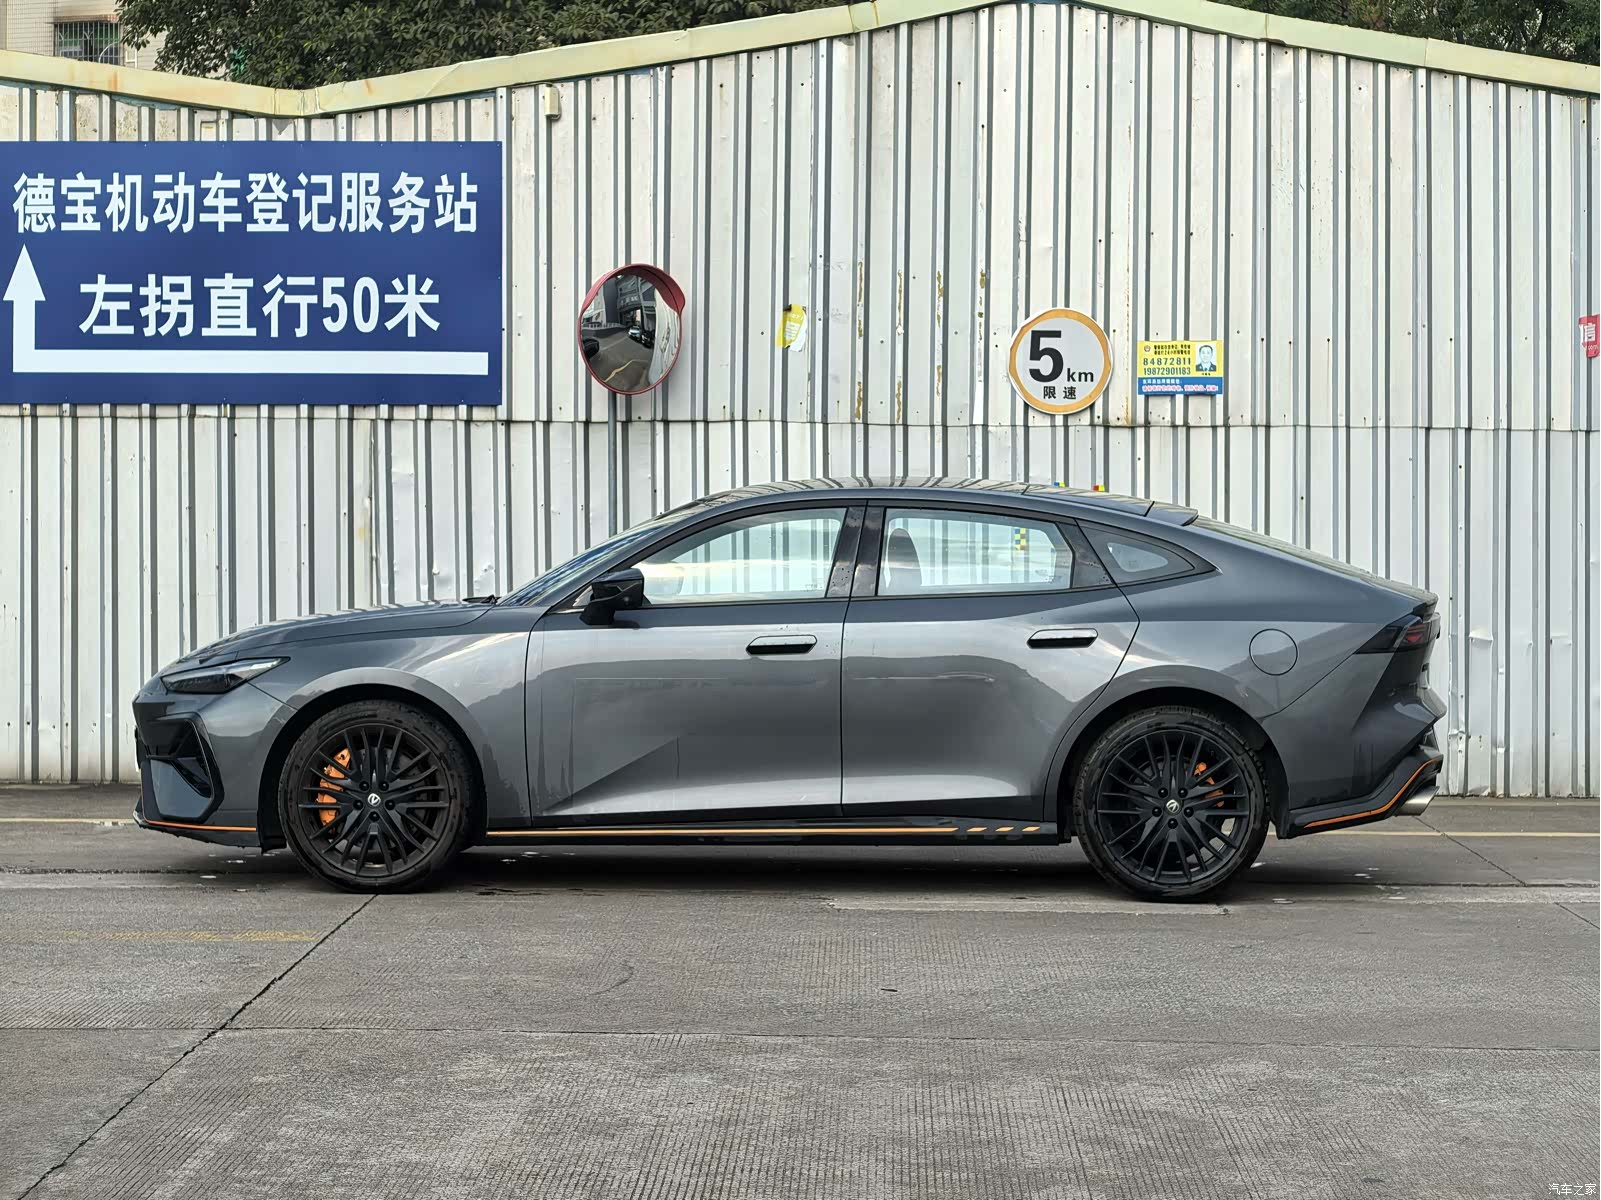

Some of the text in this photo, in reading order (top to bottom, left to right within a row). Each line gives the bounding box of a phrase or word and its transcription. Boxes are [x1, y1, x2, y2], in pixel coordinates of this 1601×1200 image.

[13, 171, 478, 234] 德宝机动车登记服务站
[79, 273, 441, 338] 左拐直行50米
[1029, 330, 1094, 382] 5 km
[1143, 357, 1191, 366] 84872811
[1043, 386, 1076, 399] 限速
